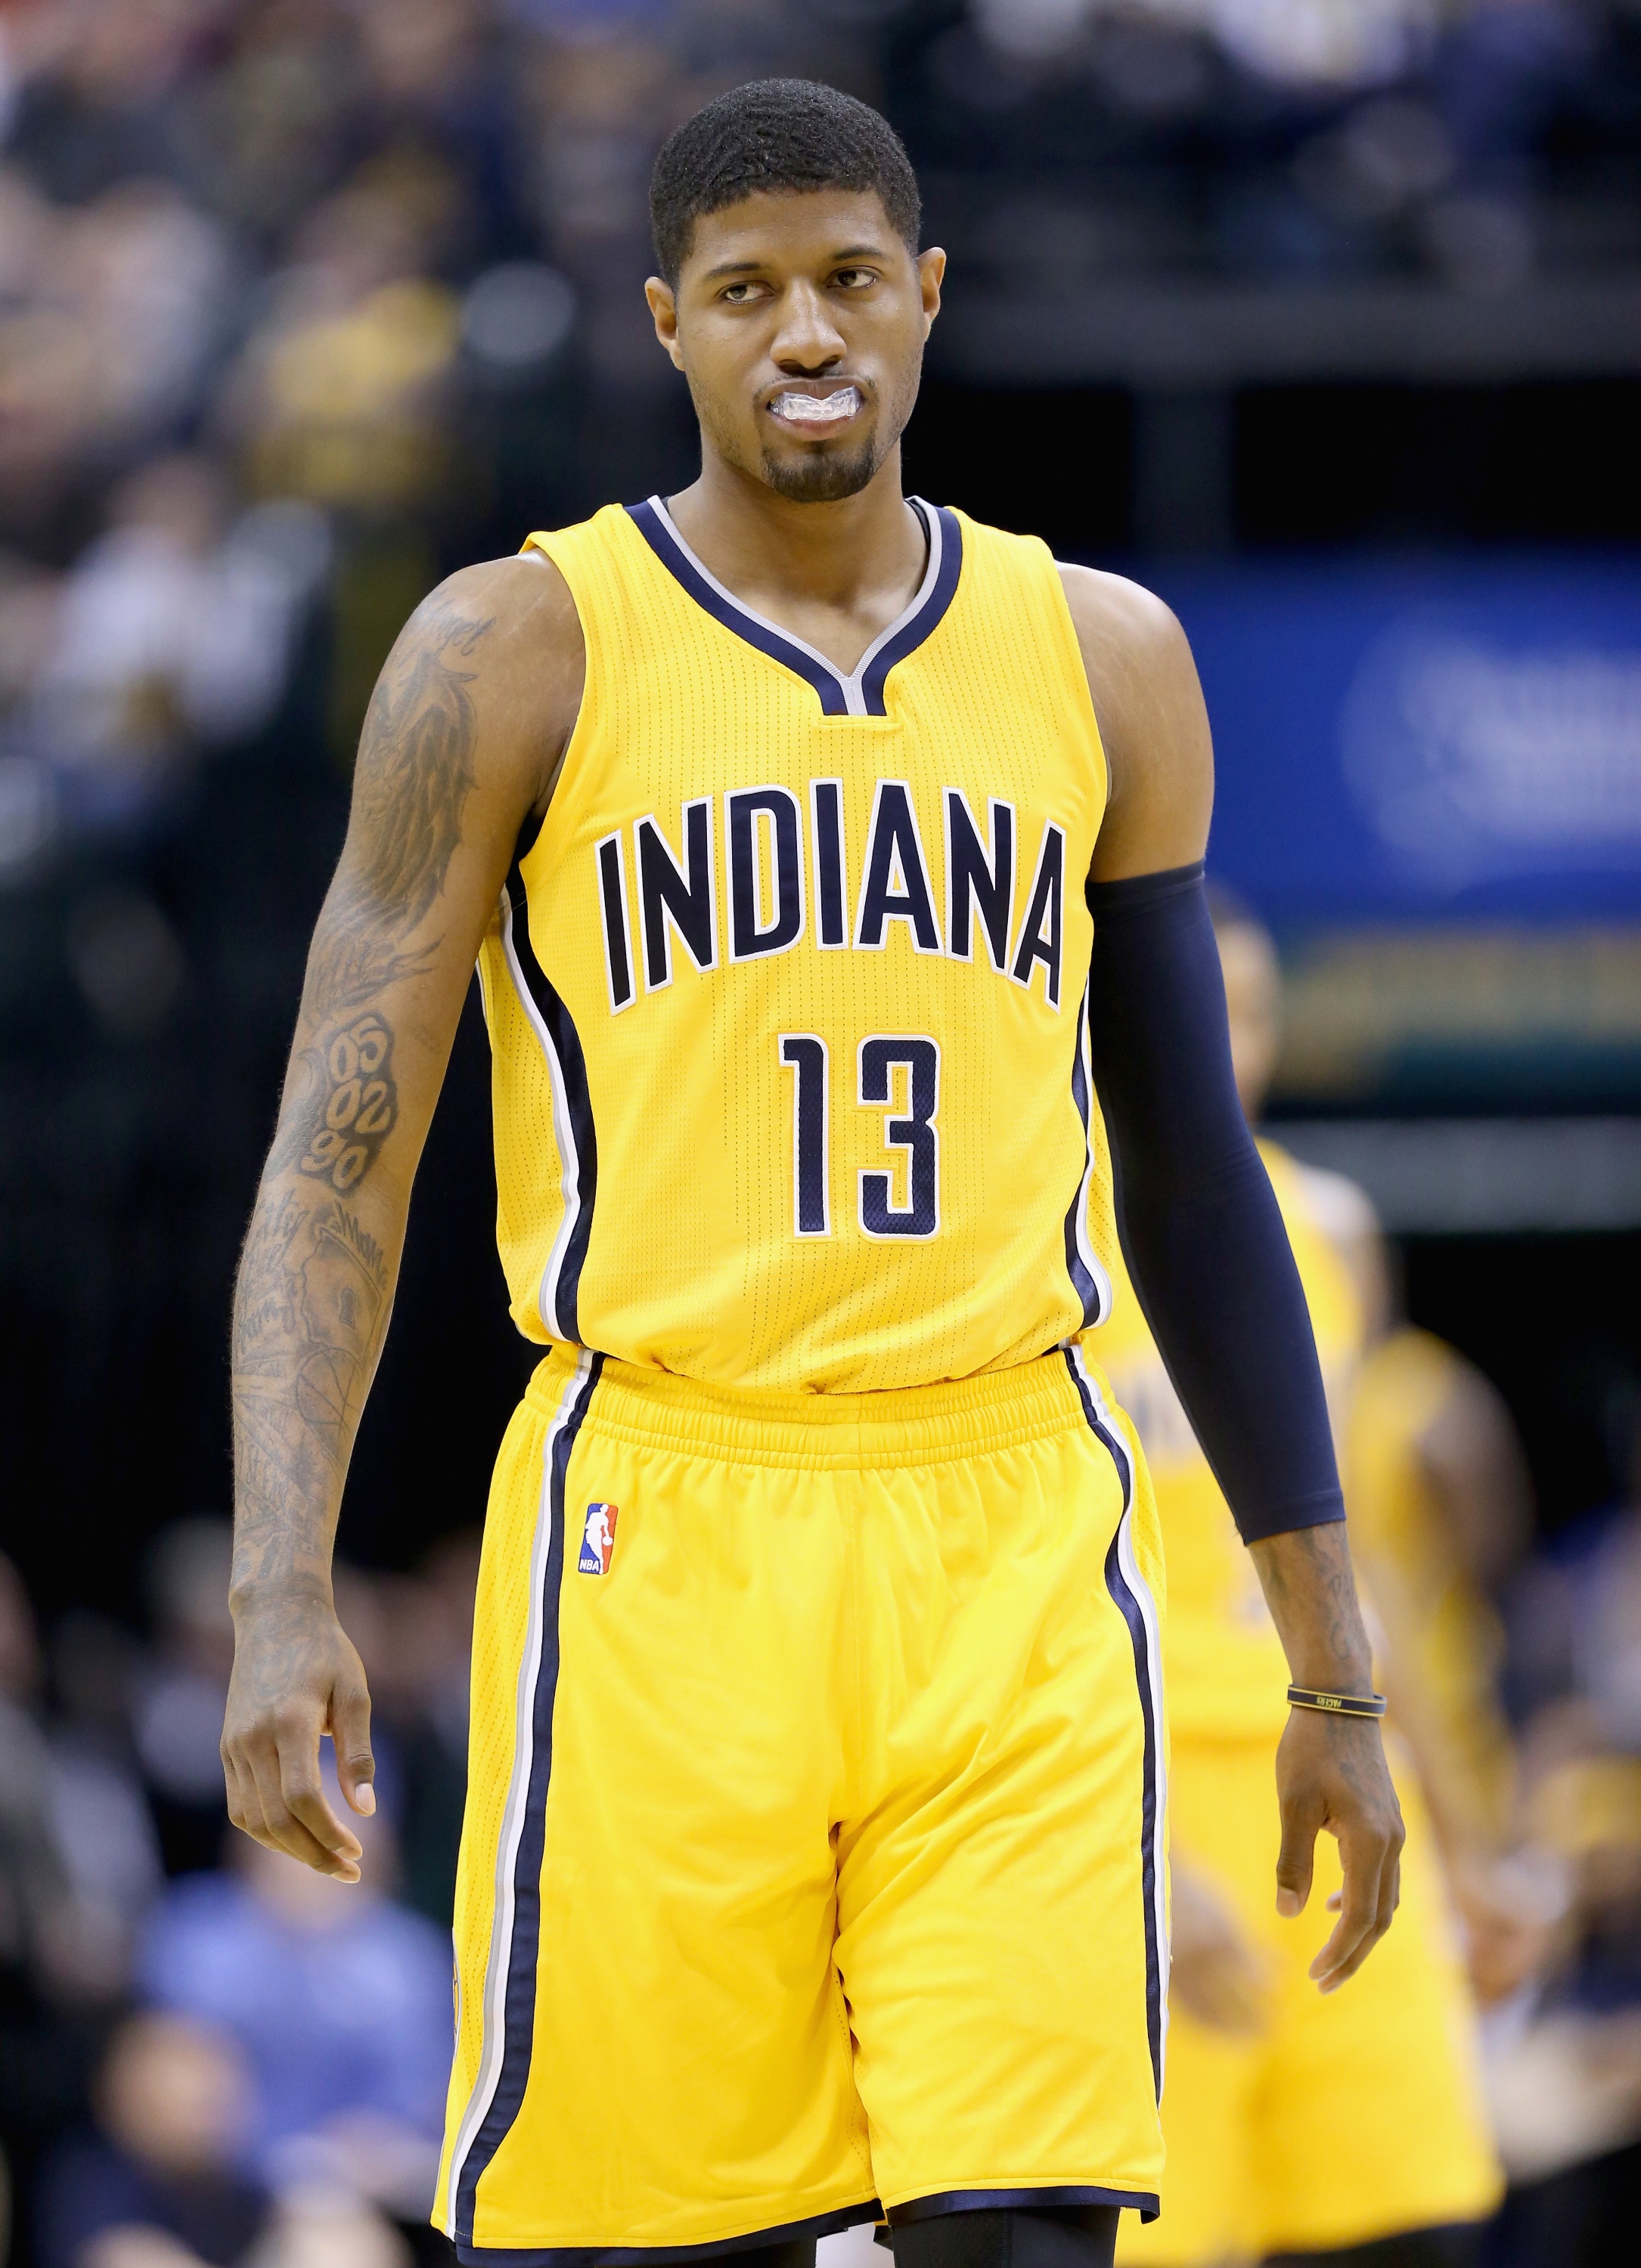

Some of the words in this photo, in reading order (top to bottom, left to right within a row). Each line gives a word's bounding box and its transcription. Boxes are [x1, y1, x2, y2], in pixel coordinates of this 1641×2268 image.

[594, 778, 1066, 1016] INDIANA
[329, 1015, 389, 1083] 05
[325, 1078, 392, 1133] 02
[777, 1033, 941, 1239] 13
[300, 1130, 369, 1189] 90
[579, 1559, 599, 1571] NBA
